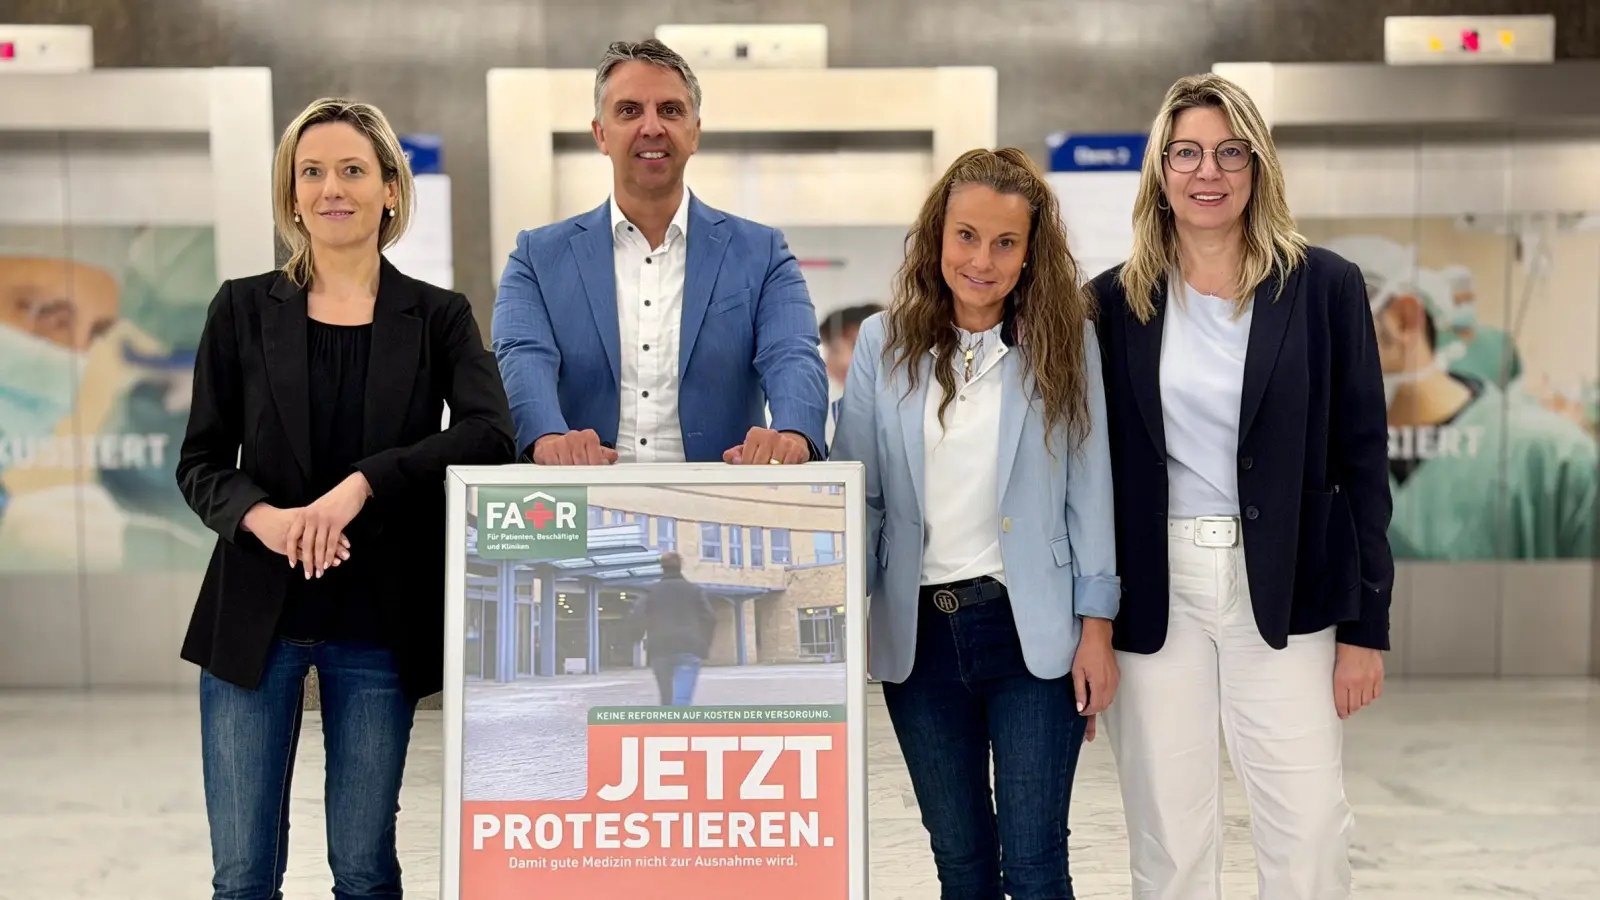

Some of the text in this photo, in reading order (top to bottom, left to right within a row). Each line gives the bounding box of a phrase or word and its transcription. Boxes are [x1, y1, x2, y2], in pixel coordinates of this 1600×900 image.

[486, 533, 580, 541] Für Patienten, Beschäftigte
[596, 710, 832, 720] KEINE REFORMEN AUF KOSTEN DER VERSORGUNG.
[596, 735, 833, 802] JETZT
[473, 811, 834, 850] PROTESTIEREN.
[508, 854, 798, 871] Damit gute Medizin nicht zur Ausnahme wird.
